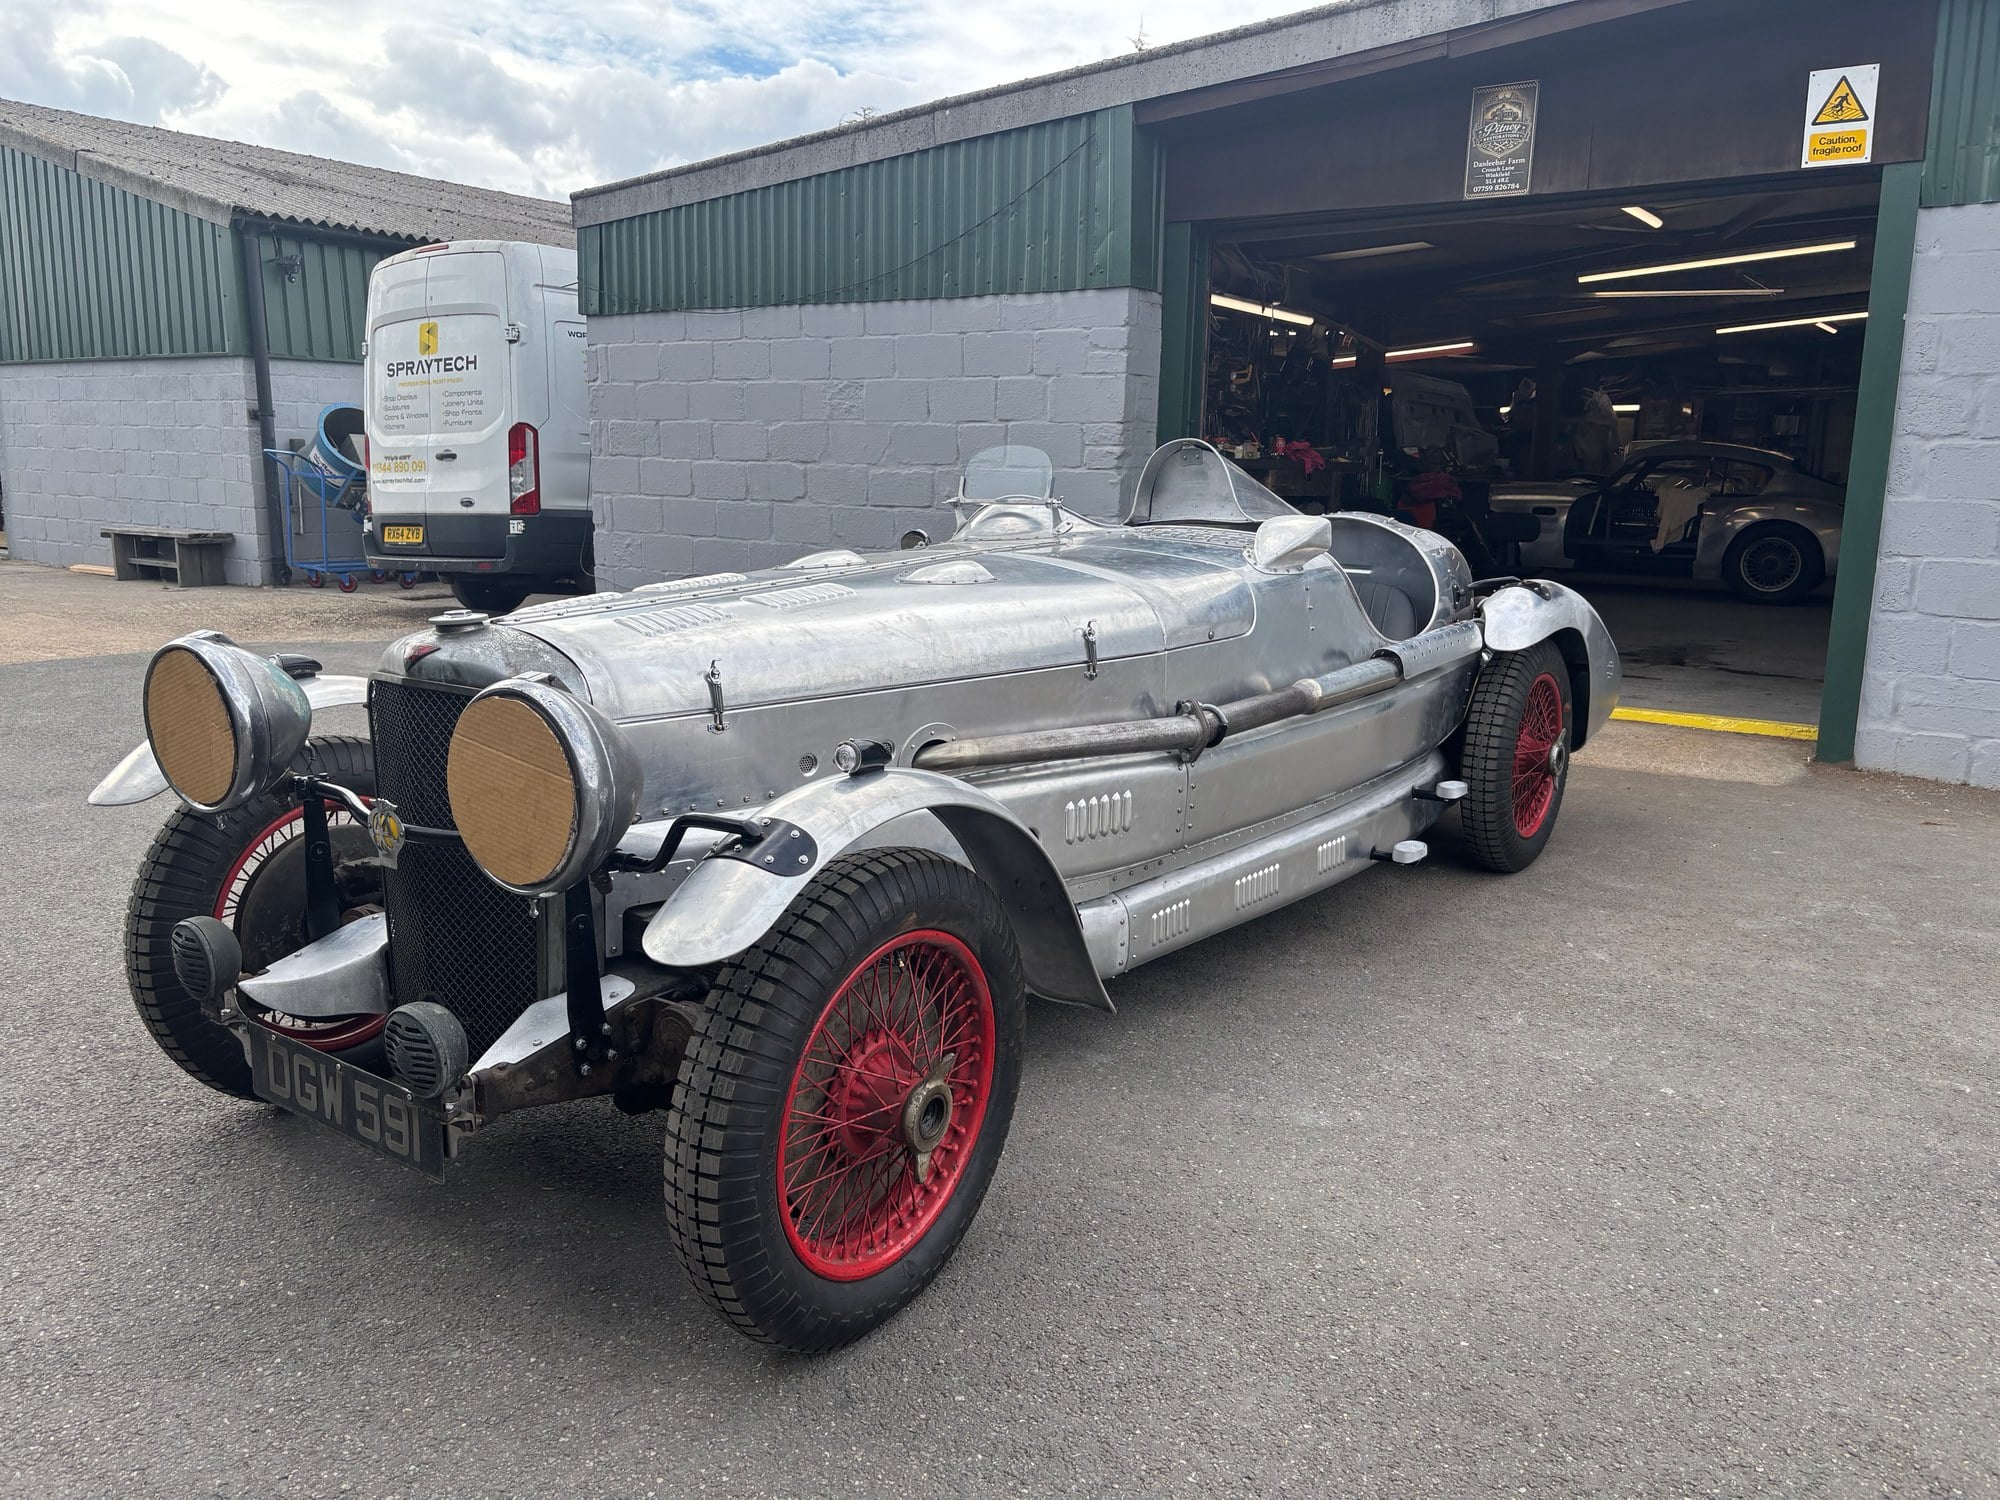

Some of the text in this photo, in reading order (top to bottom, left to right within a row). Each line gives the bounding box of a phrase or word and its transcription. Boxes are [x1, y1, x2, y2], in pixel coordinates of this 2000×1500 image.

[1819, 136, 1857, 145] Caution,
[1812, 143, 1862, 156] fragile roof
[386, 355, 478, 378] SPRAYTECH
[394, 460, 409, 473] 890
[411, 459, 426, 472] 091
[387, 528, 404, 540] RX64
[266, 1041, 421, 1163] DGW 591
